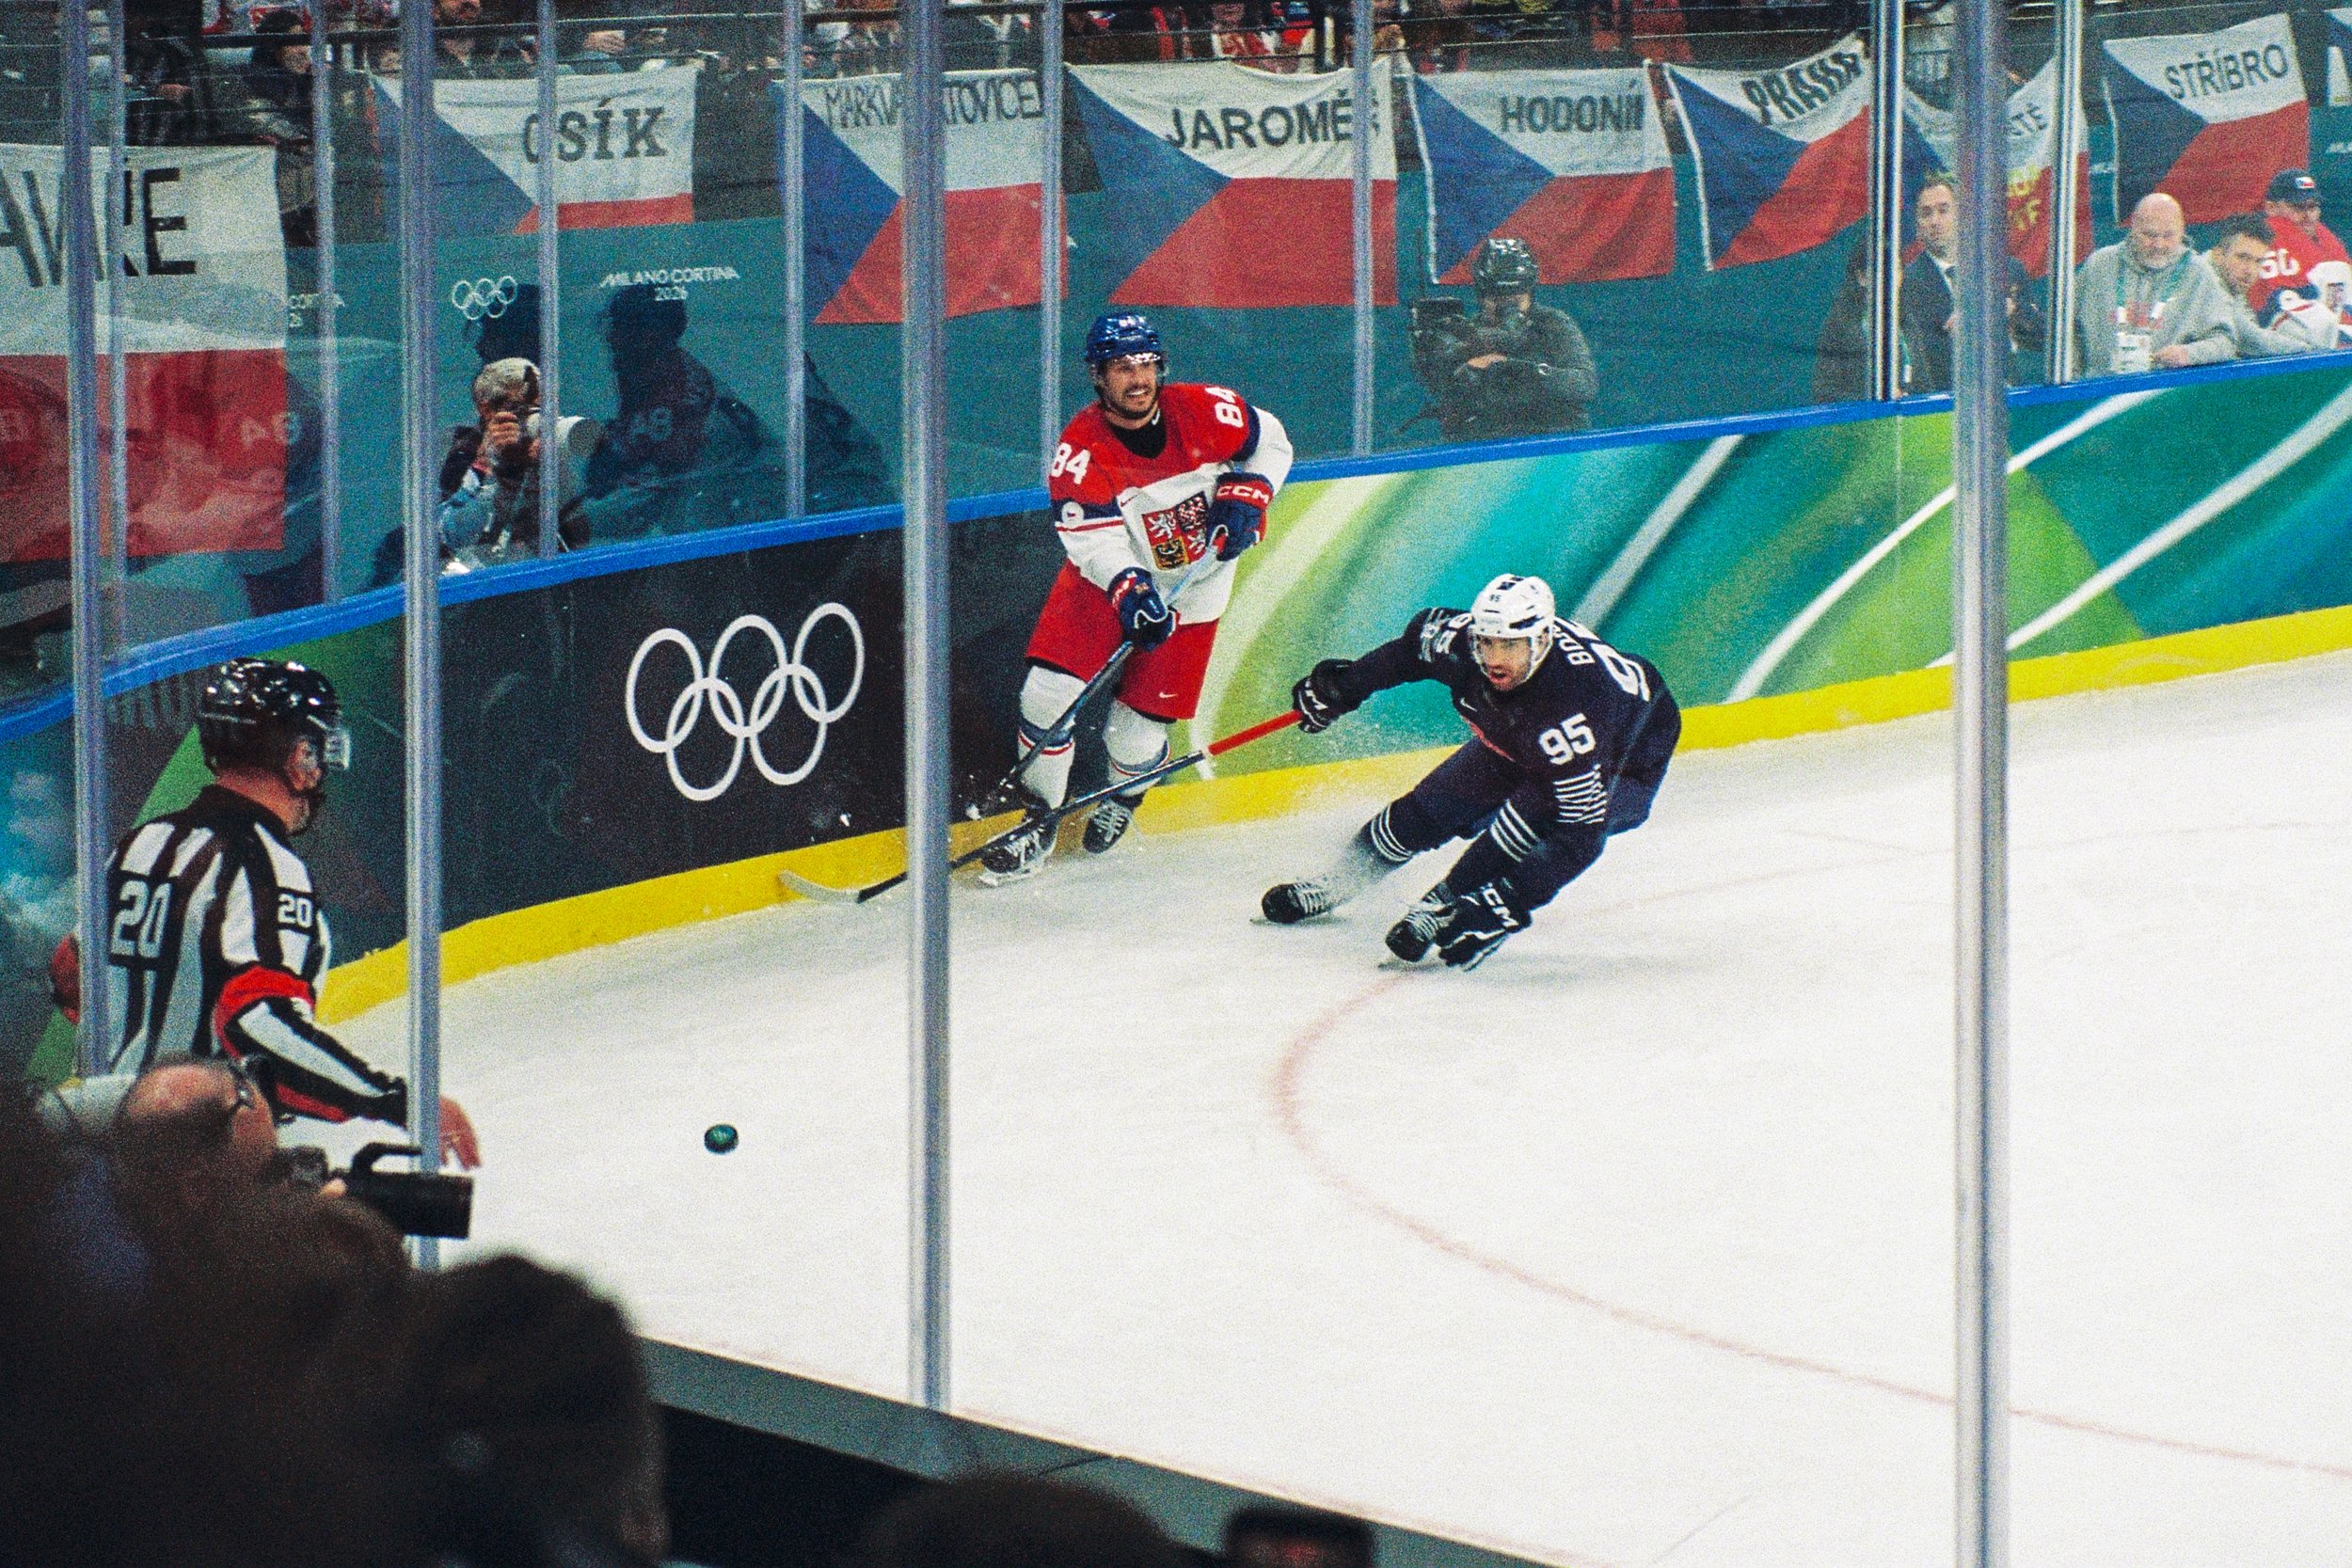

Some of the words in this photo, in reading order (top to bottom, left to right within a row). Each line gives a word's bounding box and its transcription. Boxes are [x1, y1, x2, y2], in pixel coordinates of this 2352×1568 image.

[2165, 44, 2288, 100] STŘÍBRO
[1205, 385, 1245, 429] 84
[1050, 442, 1091, 484] 84
[1216, 484, 1270, 505] CCM
[1538, 712, 1597, 766] 95
[110, 879, 172, 959] 20
[277, 893, 313, 928] 20
